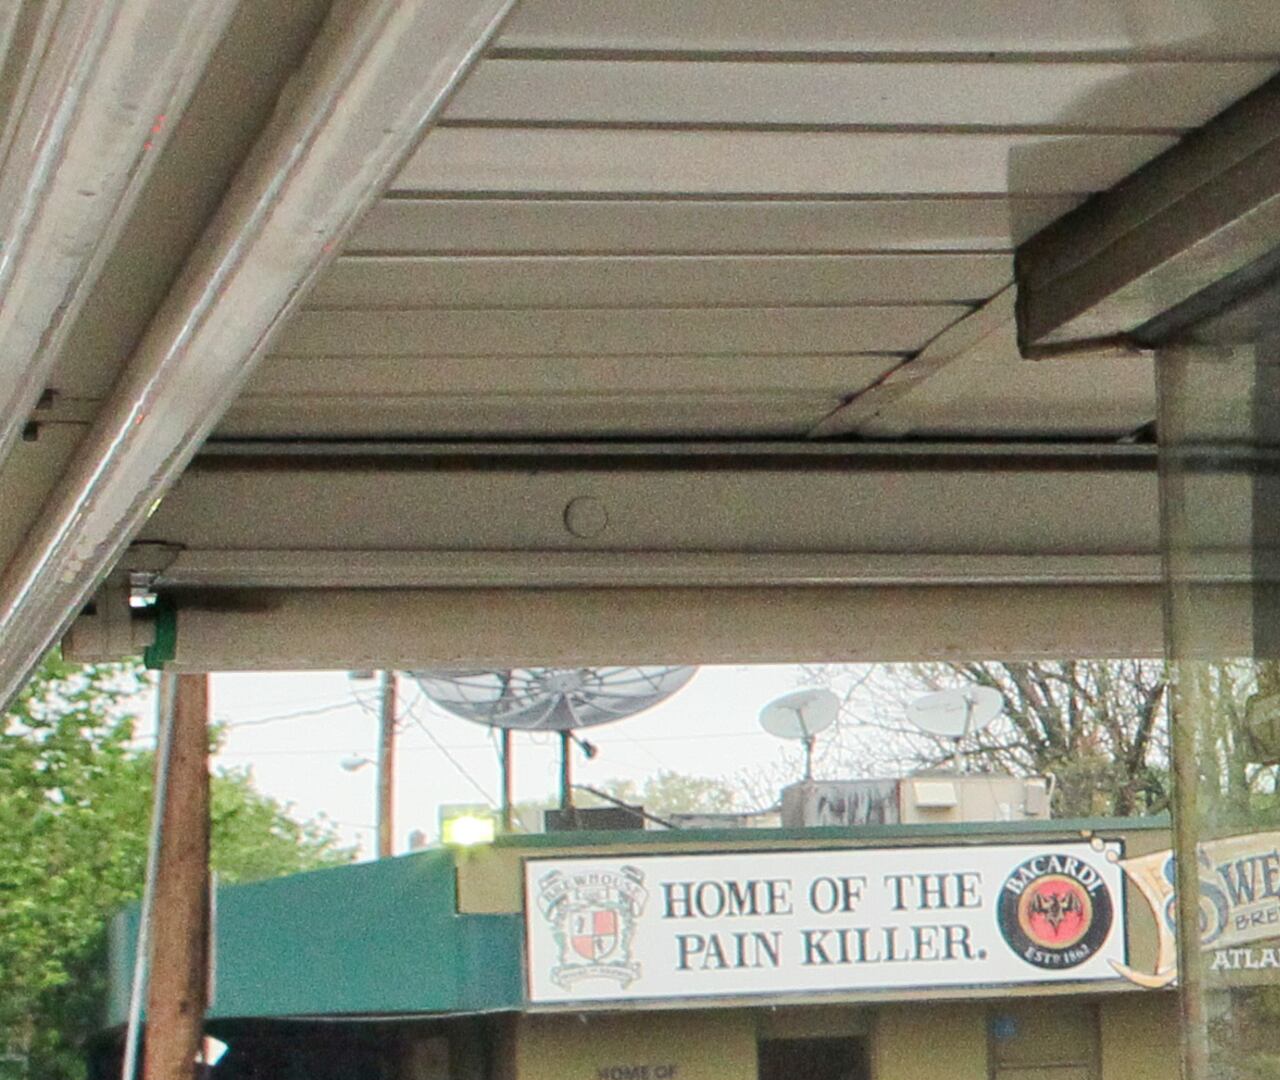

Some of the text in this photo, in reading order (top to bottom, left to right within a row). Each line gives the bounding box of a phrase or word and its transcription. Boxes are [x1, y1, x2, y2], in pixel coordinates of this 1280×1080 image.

[660, 872, 983, 919] HOME OF THE
[675, 924, 988, 971] PAIN KILLER.
[598, 1066, 650, 1080] HOME
